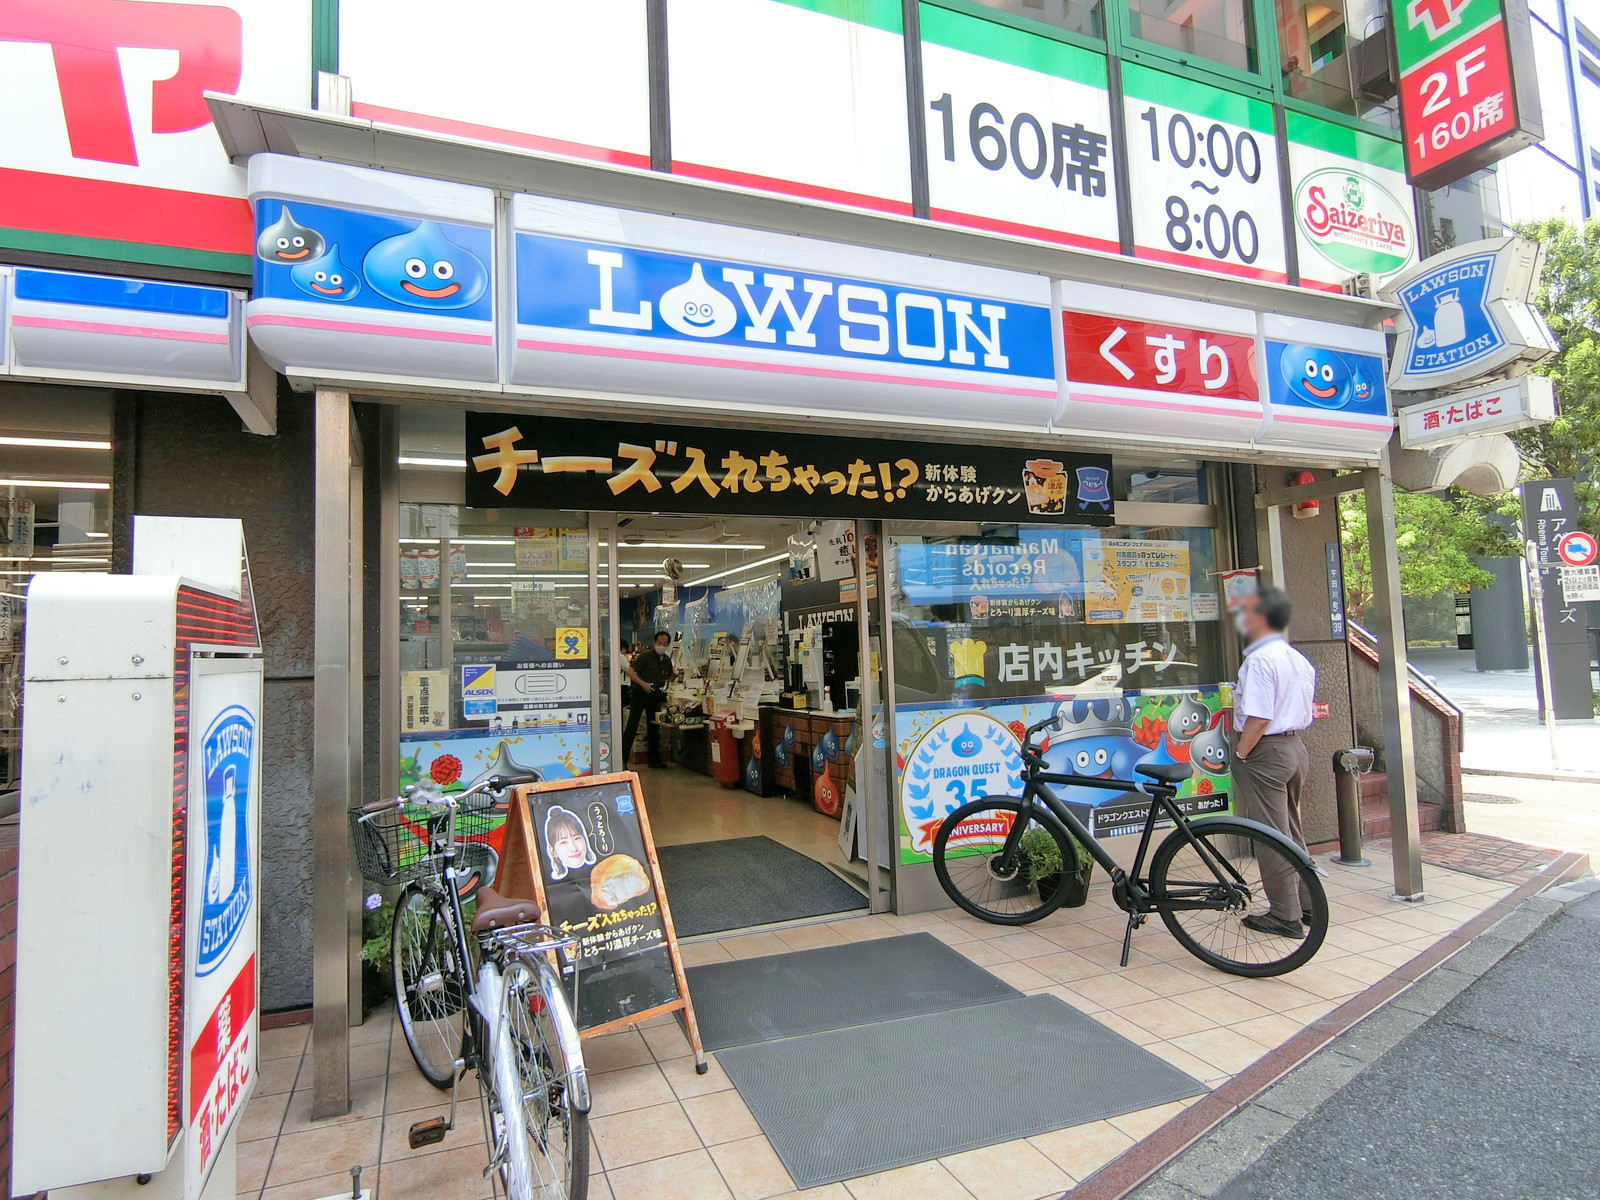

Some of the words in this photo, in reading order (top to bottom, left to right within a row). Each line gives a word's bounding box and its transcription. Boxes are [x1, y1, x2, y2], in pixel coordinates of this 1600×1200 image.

[1419, 45, 1486, 118] 2F
[930, 92, 1107, 198] 160席
[1140, 106, 1261, 184] 10:00
[1413, 91, 1504, 159] 160席
[1165, 195, 1259, 264] 8:00
[1304, 186, 1406, 242] Saizeriya
[1333, 231, 1369, 245] RISTORANTE
[1407, 263, 1486, 303] LAWSON
[587, 249, 1010, 369] LWSON
[1098, 326, 1230, 390] くすり
[1414, 333, 1492, 367] STATION
[925, 463, 978, 483] 新体験
[925, 484, 1022, 506] からあげクン
[1537, 518, 1547, 545] Abema
[1540, 545, 1550, 575] Towrs
[799, 608, 854, 630] LAWSON
[1333, 622, 1342, 633] 39
[997, 640, 1178, 683] 店内キッチン
[419, 677, 430, 725] 重点警戒中
[207, 723, 251, 781] LAWSON
[934, 766, 970, 779] DRAGON
[972, 762, 1001, 775] QUEST
[949, 823, 1005, 837] NIVERSARY
[202, 876, 248, 954] STATION
